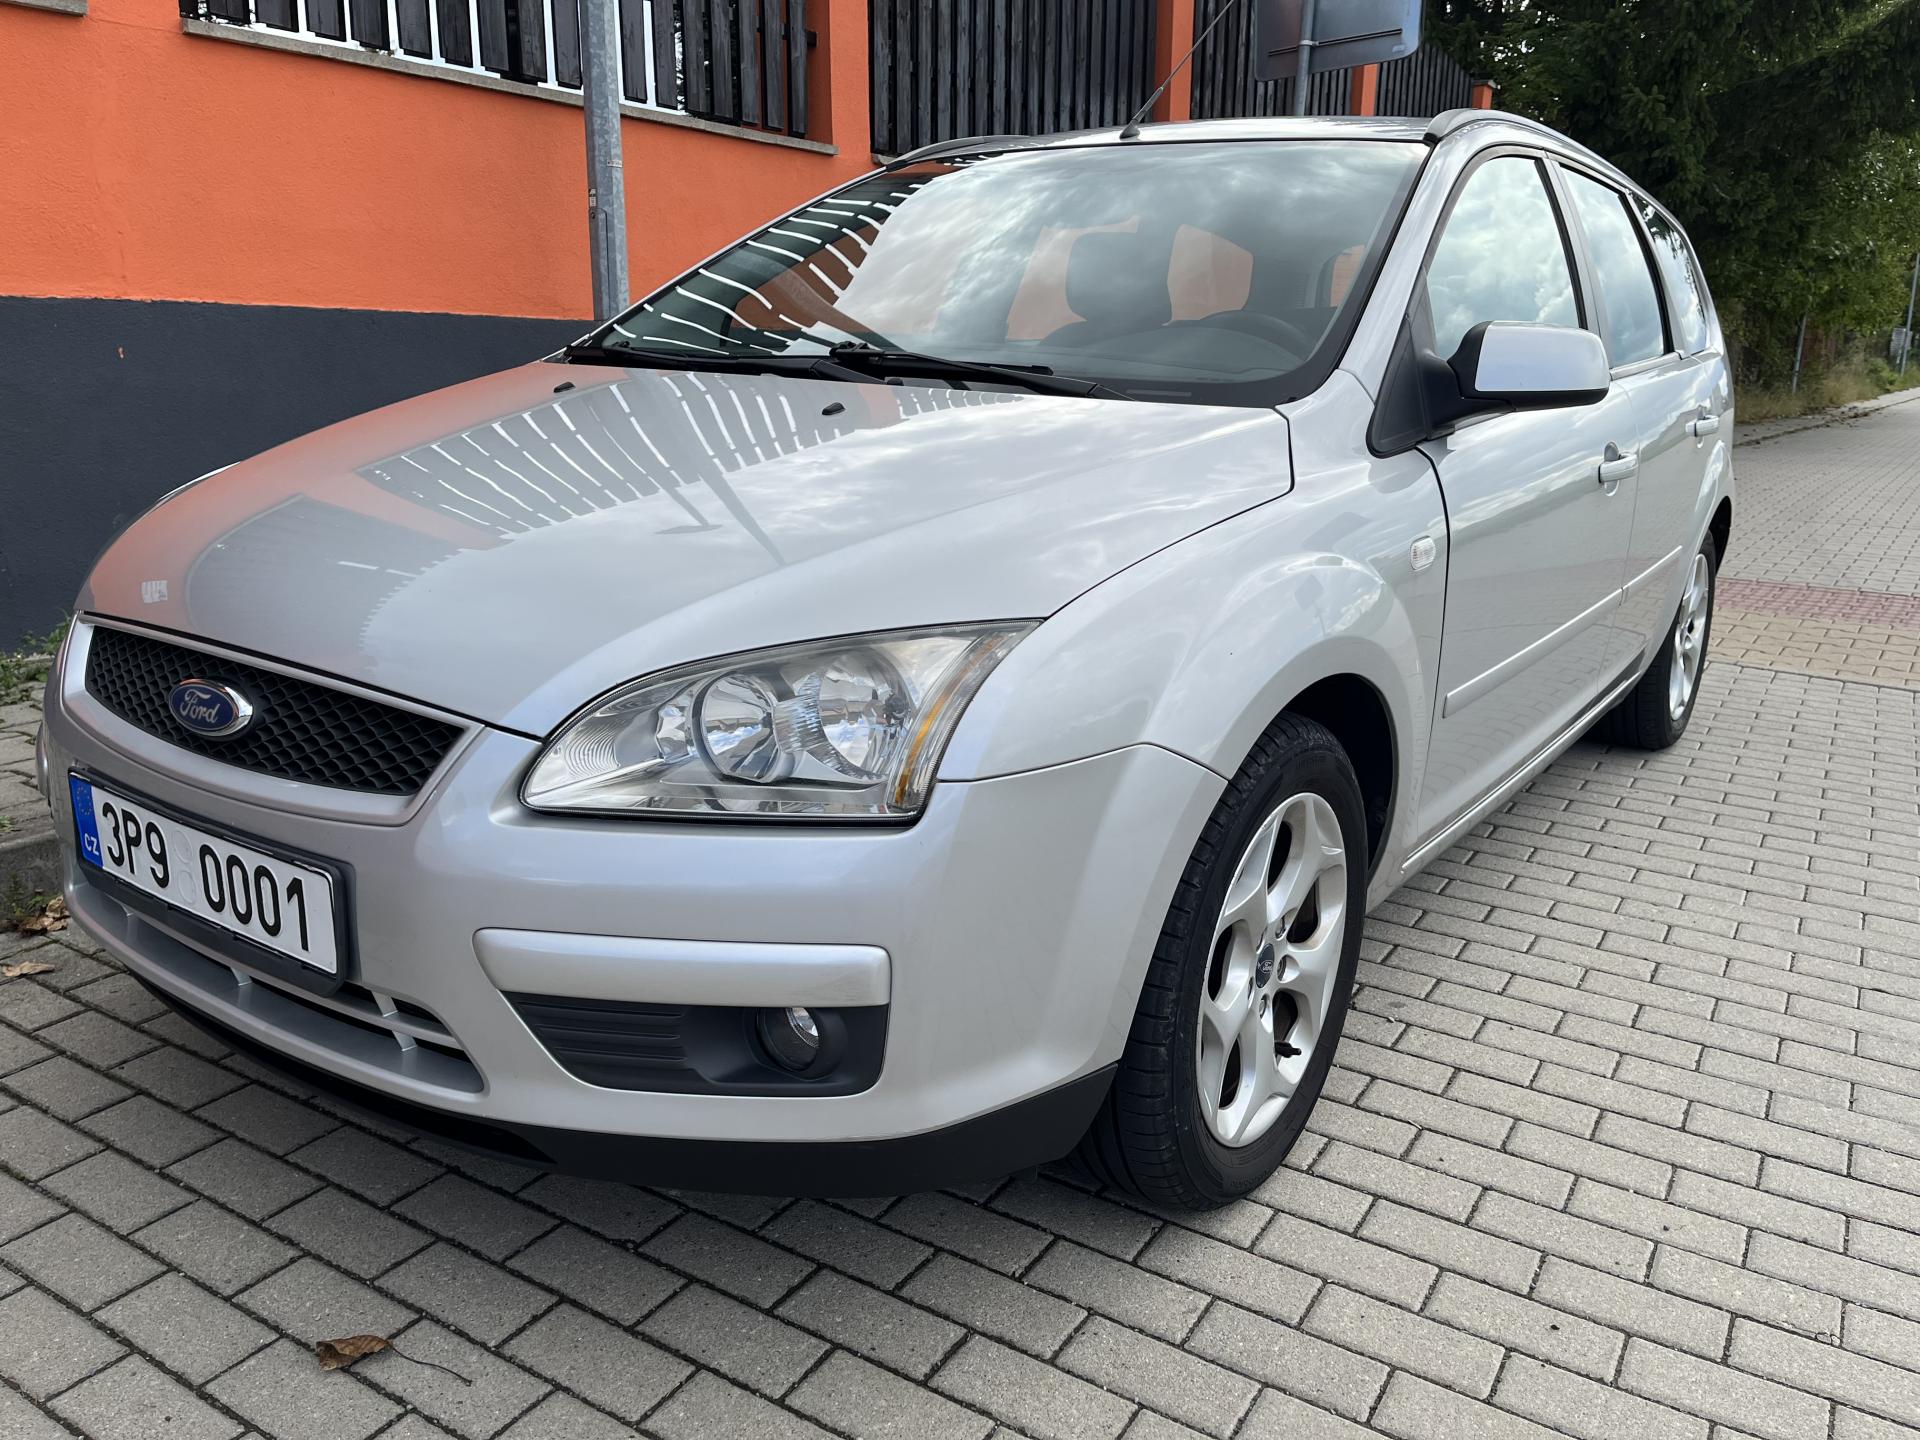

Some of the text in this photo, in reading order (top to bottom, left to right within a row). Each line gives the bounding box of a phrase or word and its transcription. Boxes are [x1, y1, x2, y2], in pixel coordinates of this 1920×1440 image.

[180, 688, 221, 723] Ford
[84, 832, 99, 855] CZ
[102, 801, 310, 952] 3P9 0001
